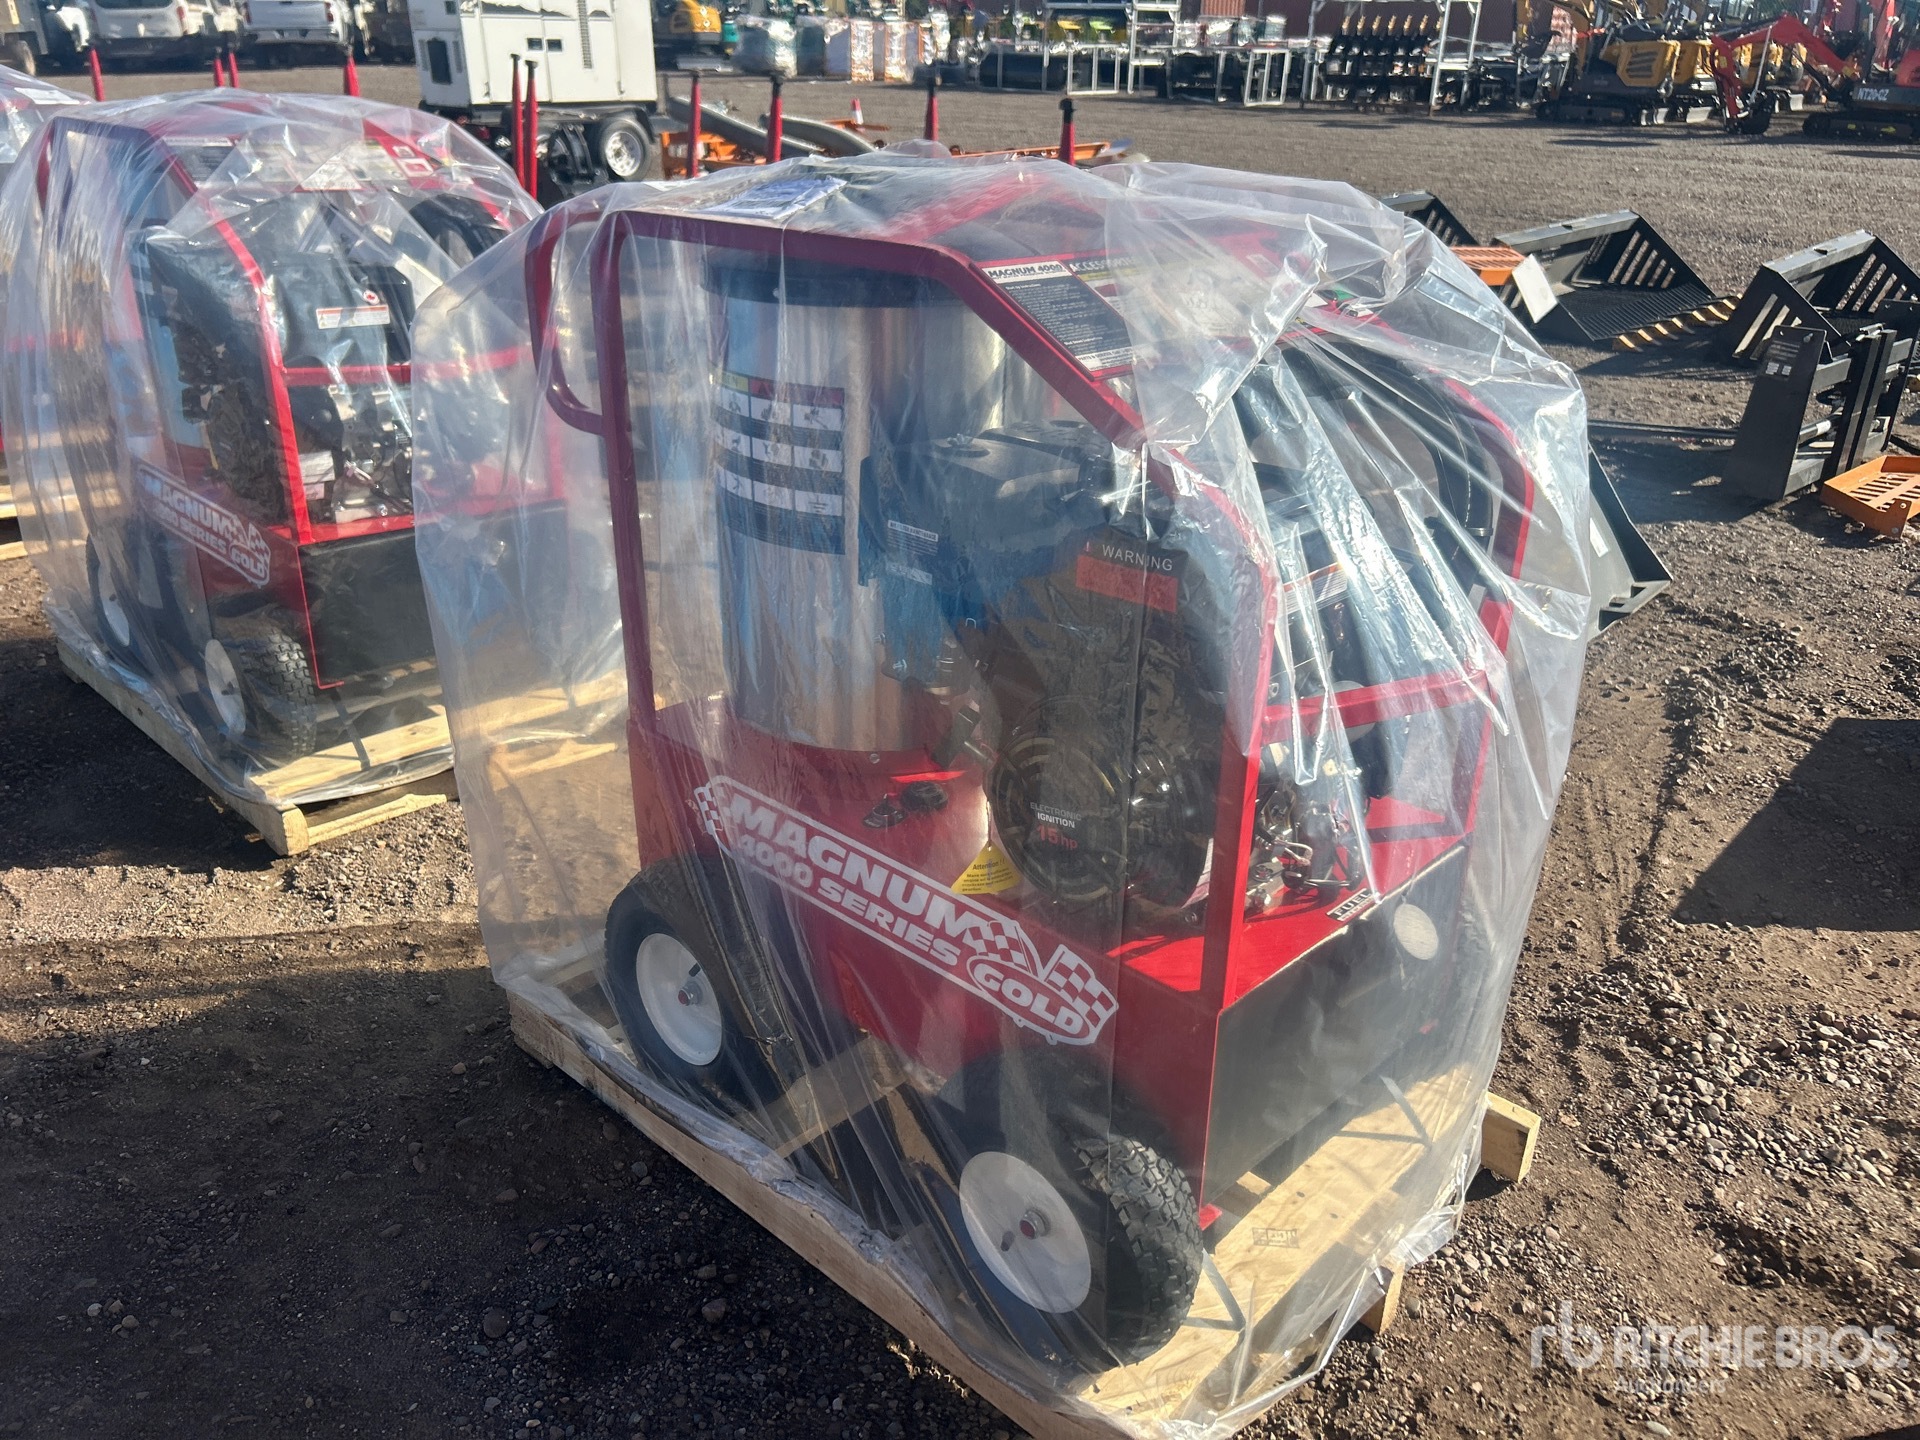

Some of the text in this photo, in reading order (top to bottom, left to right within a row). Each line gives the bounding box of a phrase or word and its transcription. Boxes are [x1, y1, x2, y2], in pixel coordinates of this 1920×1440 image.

[988, 265, 1036, 279] MAGNUM
[1038, 263, 1063, 272] 4000
[231, 547, 266, 578] GOLD
[1102, 544, 1173, 571] WARNING
[1029, 801, 1082, 821] ELECTRONIC
[1037, 811, 1076, 829] IGNITION
[1036, 824, 1078, 850] 15 hp
[730, 792, 989, 938] MAGNUM
[740, 834, 961, 966] 4000 SERIES
[1334, 891, 1372, 916] FUEL
[974, 963, 1084, 1035] GOLD
